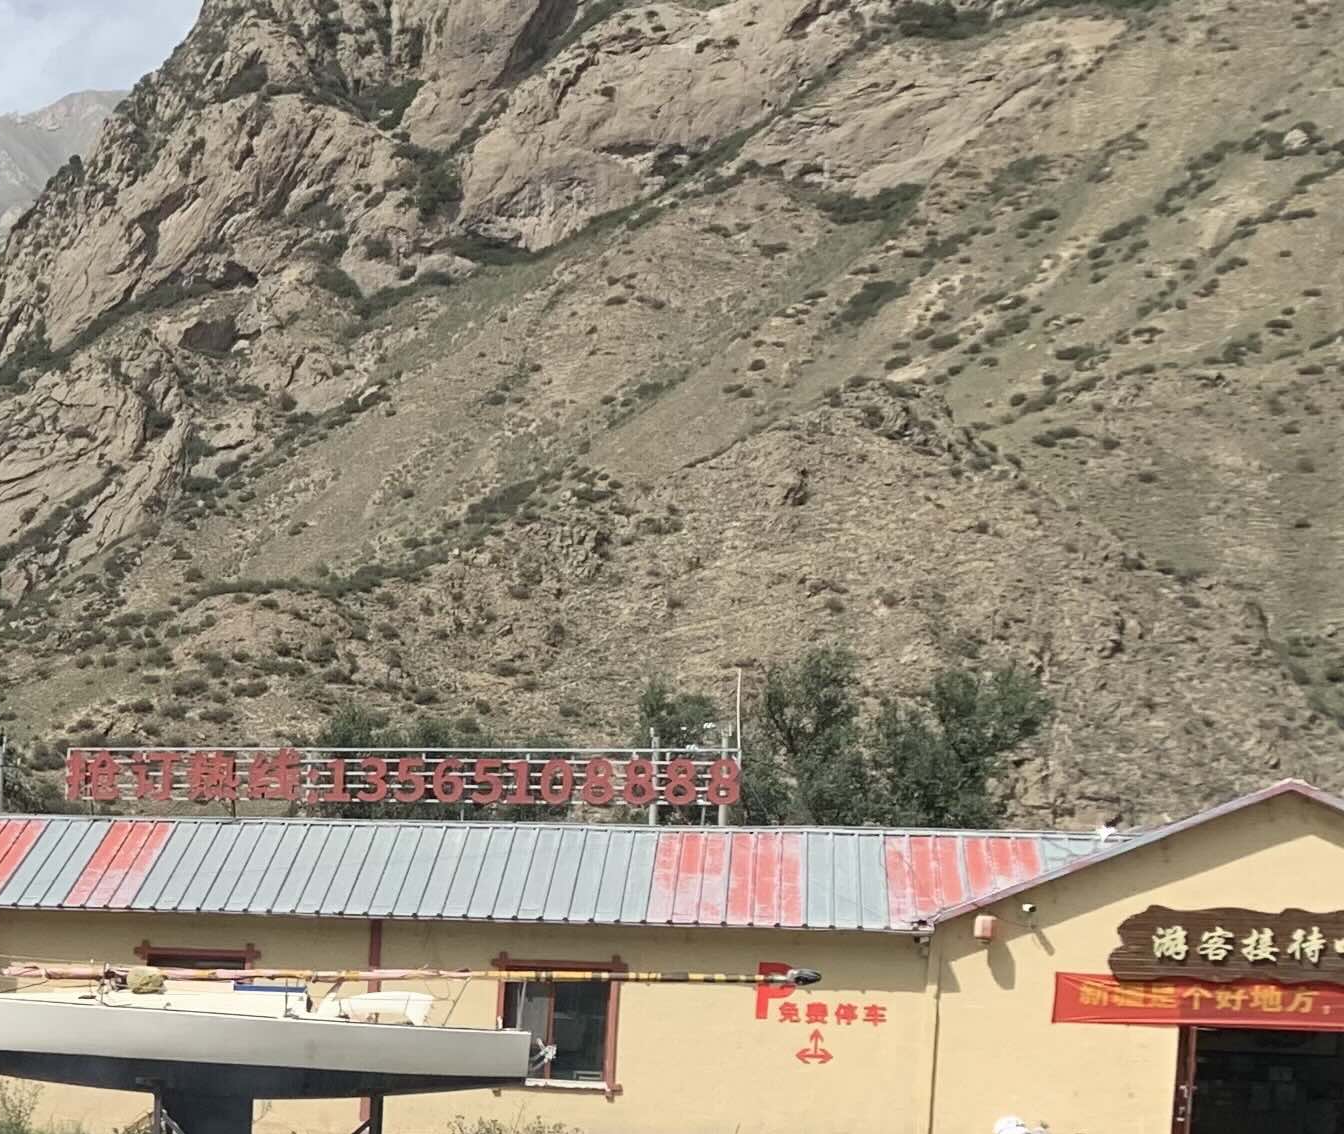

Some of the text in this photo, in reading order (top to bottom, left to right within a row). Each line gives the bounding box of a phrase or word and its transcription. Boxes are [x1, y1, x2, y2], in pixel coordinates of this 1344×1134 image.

[755, 962, 806, 1019] P
[778, 1001, 887, 1026] 免费停车
